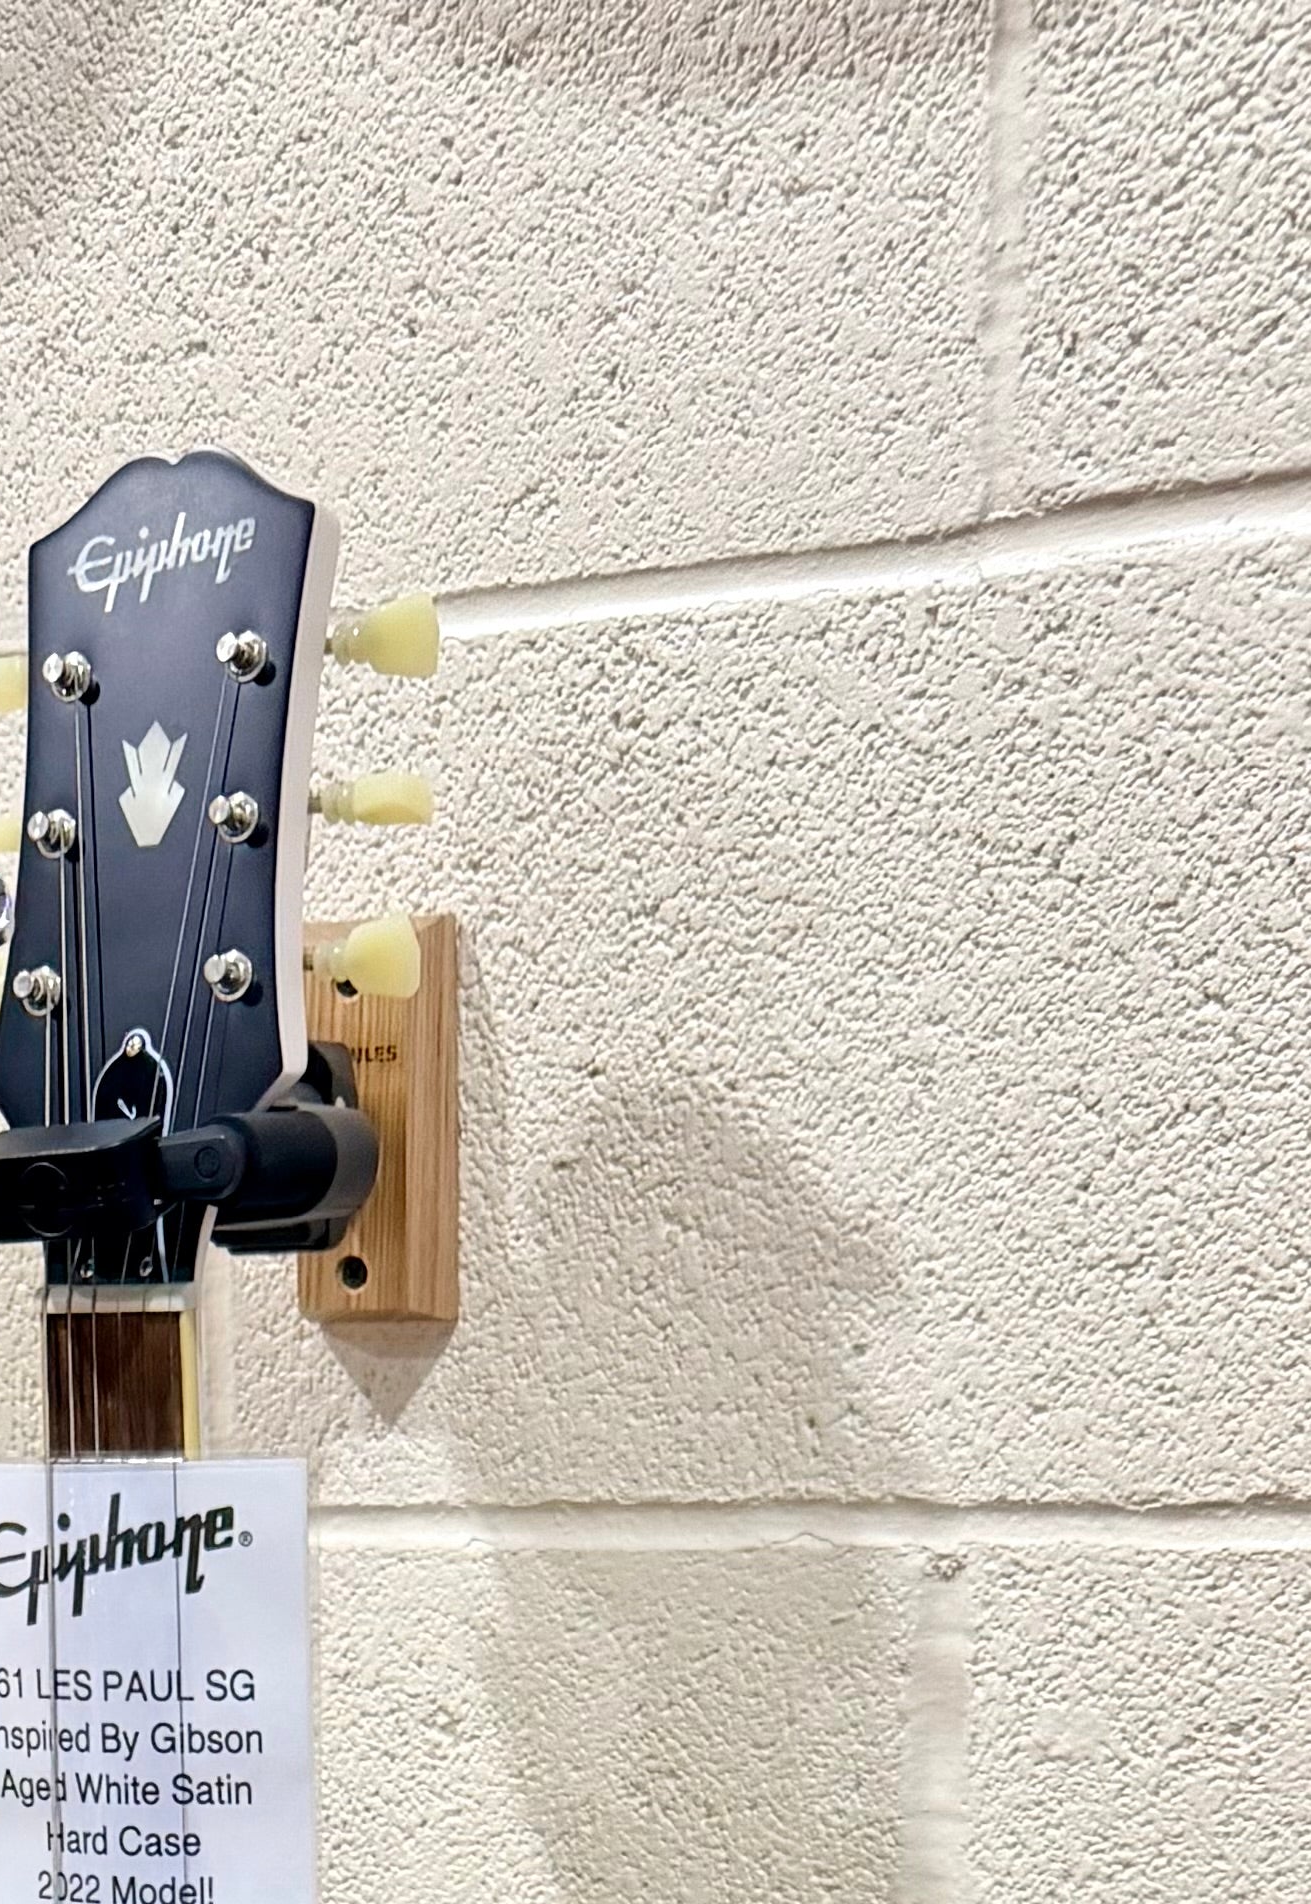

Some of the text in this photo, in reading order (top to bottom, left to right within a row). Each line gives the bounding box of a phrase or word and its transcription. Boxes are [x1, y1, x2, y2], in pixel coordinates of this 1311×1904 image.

[66, 511, 256, 613] Epiphone
[36, 1668, 92, 1700] LES
[103, 1669, 195, 1702] PAUL
[205, 1669, 256, 1702] SG
[101, 1722, 140, 1762] By
[150, 1722, 264, 1754] Gibson
[0, 1768, 253, 1807] Aged White Satin
[46, 1821, 202, 1857] Hard Case
[38, 1870, 102, 1904] 2022
